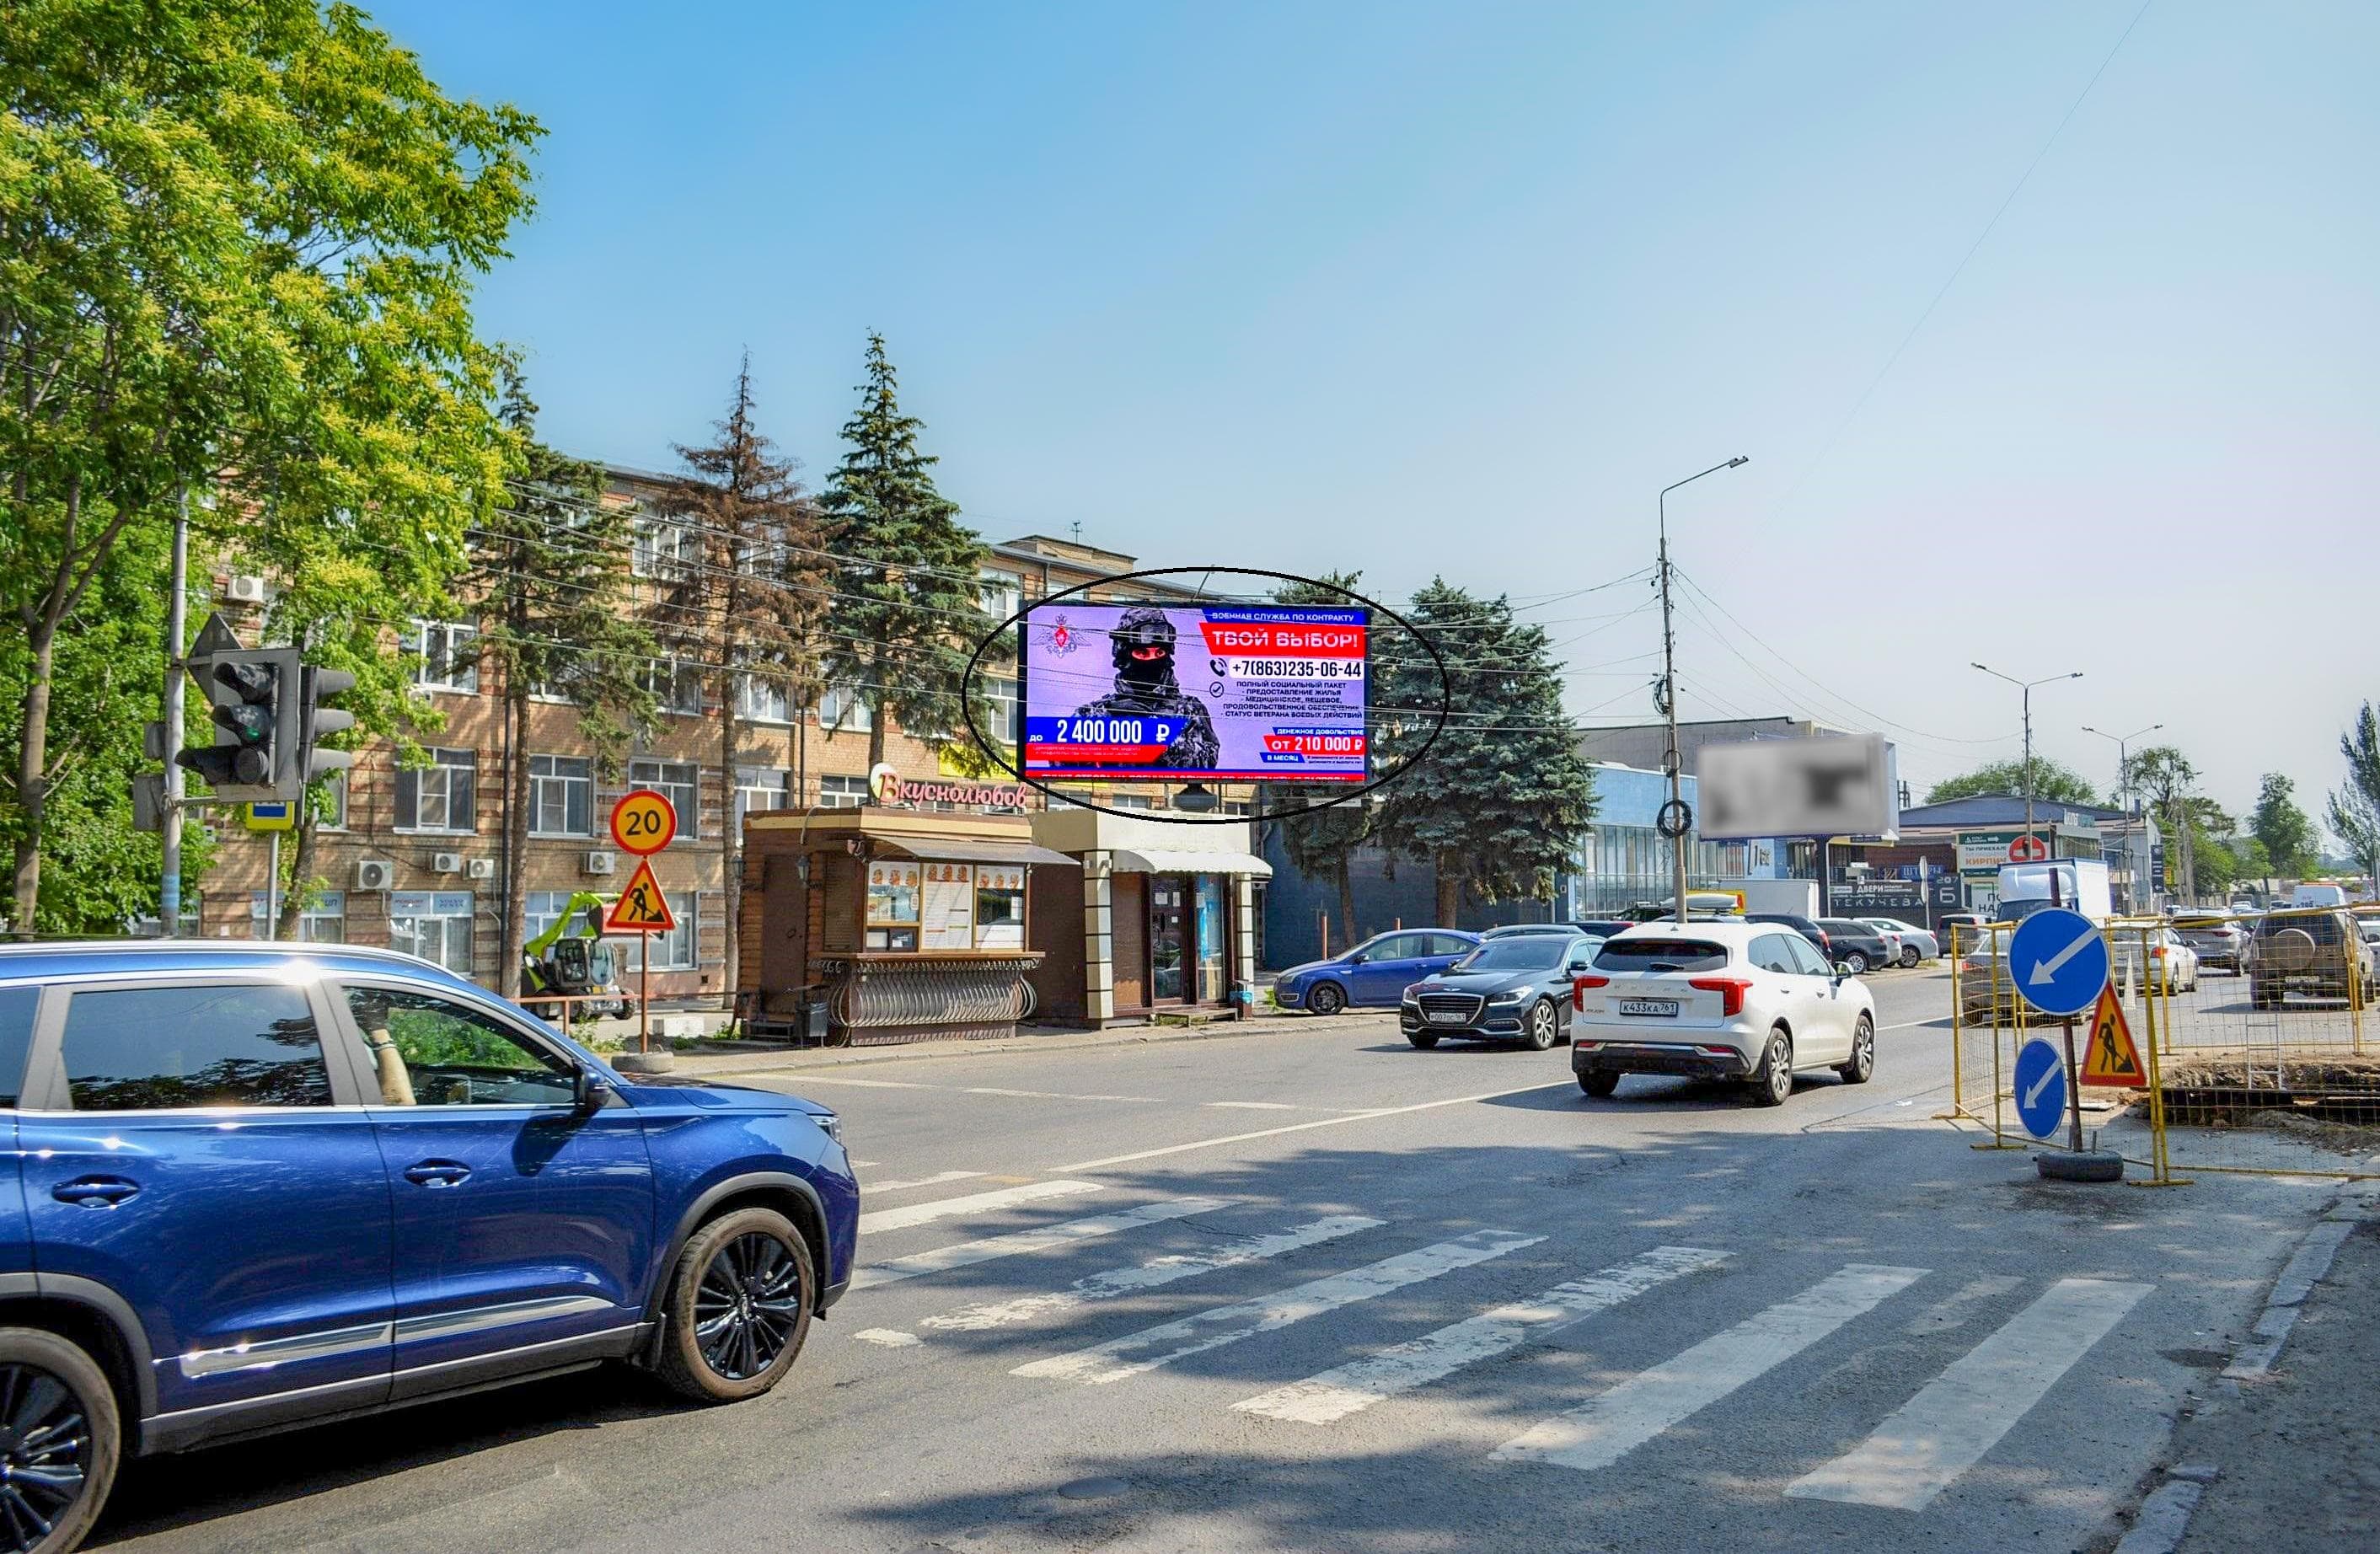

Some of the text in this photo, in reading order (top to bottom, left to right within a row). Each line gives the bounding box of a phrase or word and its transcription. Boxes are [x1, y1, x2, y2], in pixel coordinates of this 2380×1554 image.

[1212, 628, 1358, 648] ТВОЙ ВЫБОР!
[1232, 660, 1362, 678] +7(863)235-06-44
[879, 772, 1027, 807] Вкуснолюбов
[625, 809, 661, 836] 20
[1857, 885, 1884, 893] ДВЕРИ
[1833, 898, 1924, 907] ТЕКУЧЕВА
